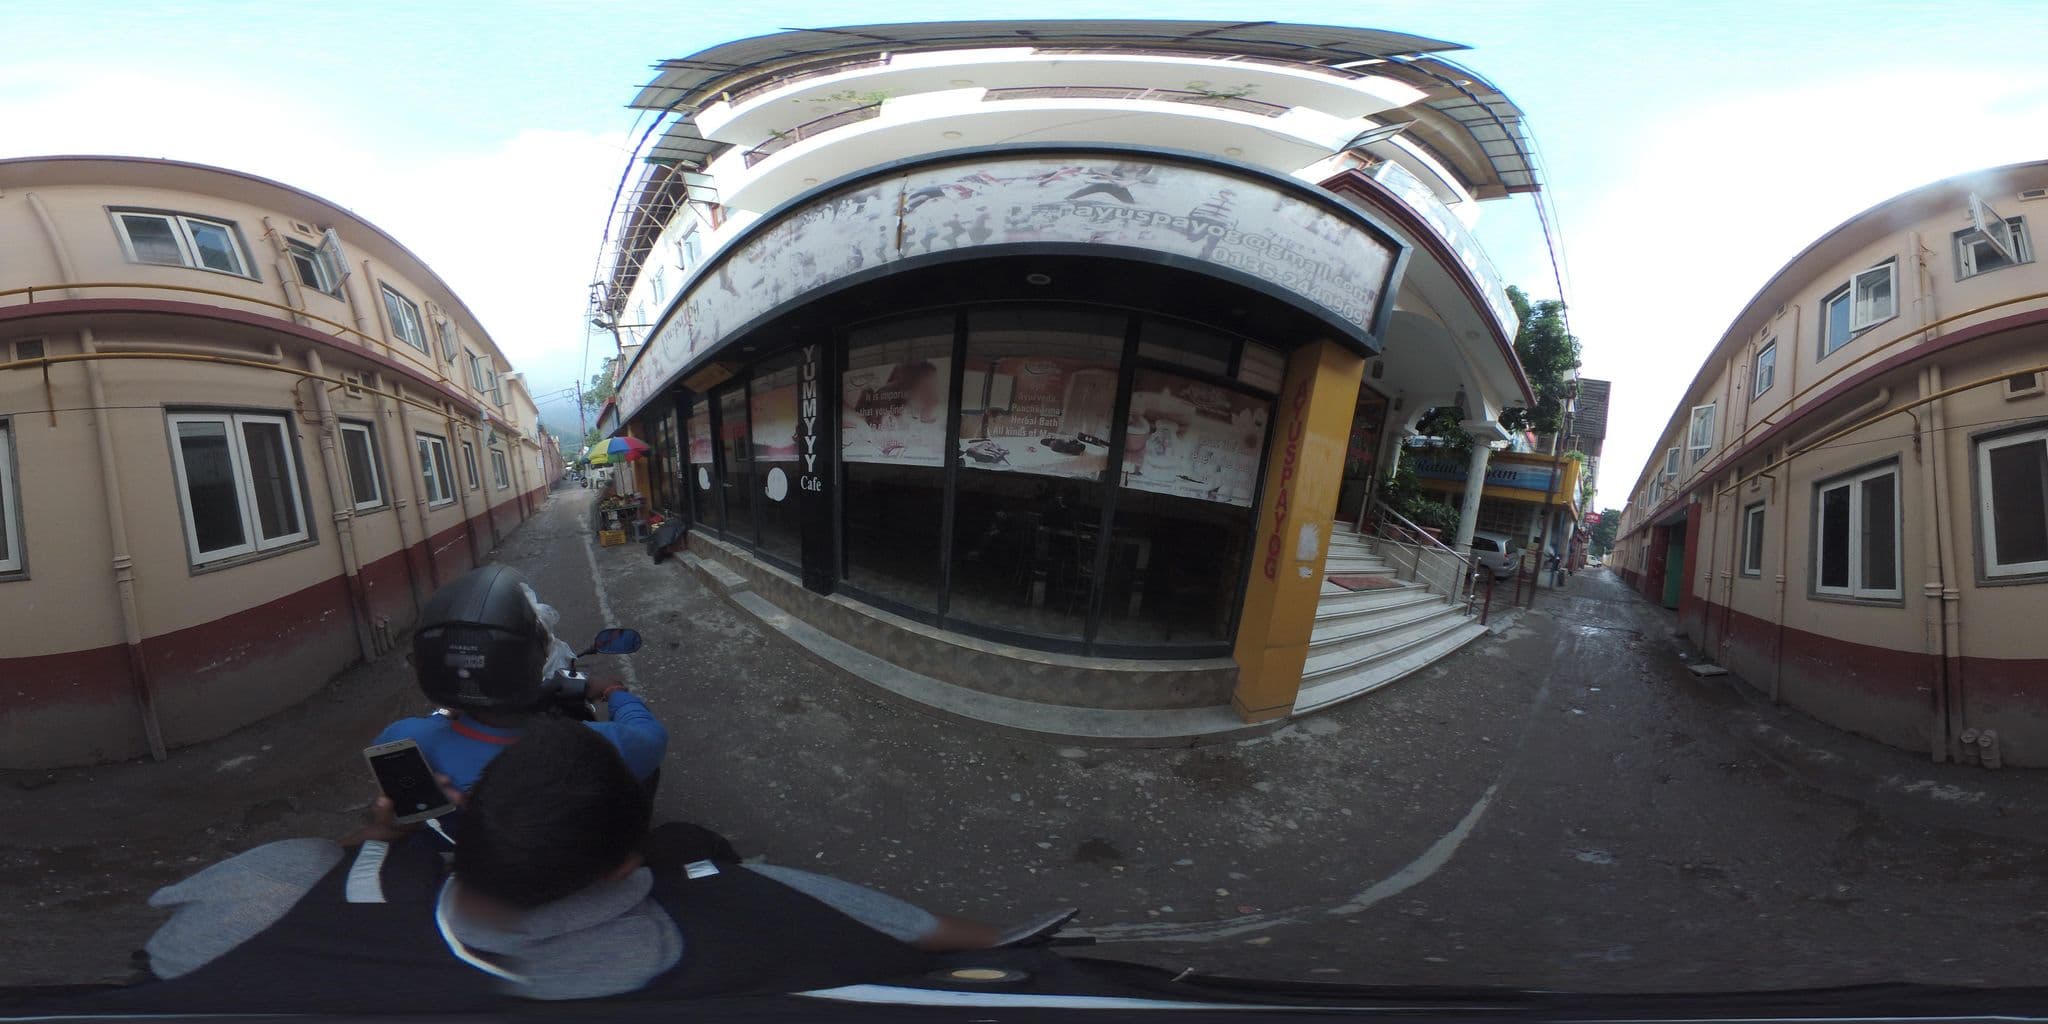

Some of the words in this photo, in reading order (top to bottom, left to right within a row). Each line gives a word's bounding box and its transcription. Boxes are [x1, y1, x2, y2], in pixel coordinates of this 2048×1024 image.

[802, 344, 817, 473] YUMMYYY
[1011, 415, 1037, 425] Herbal
[1039, 417, 1058, 427] Bath
[800, 475, 822, 493] Cafe
[1264, 378, 1308, 580] AYUSPAYOG
